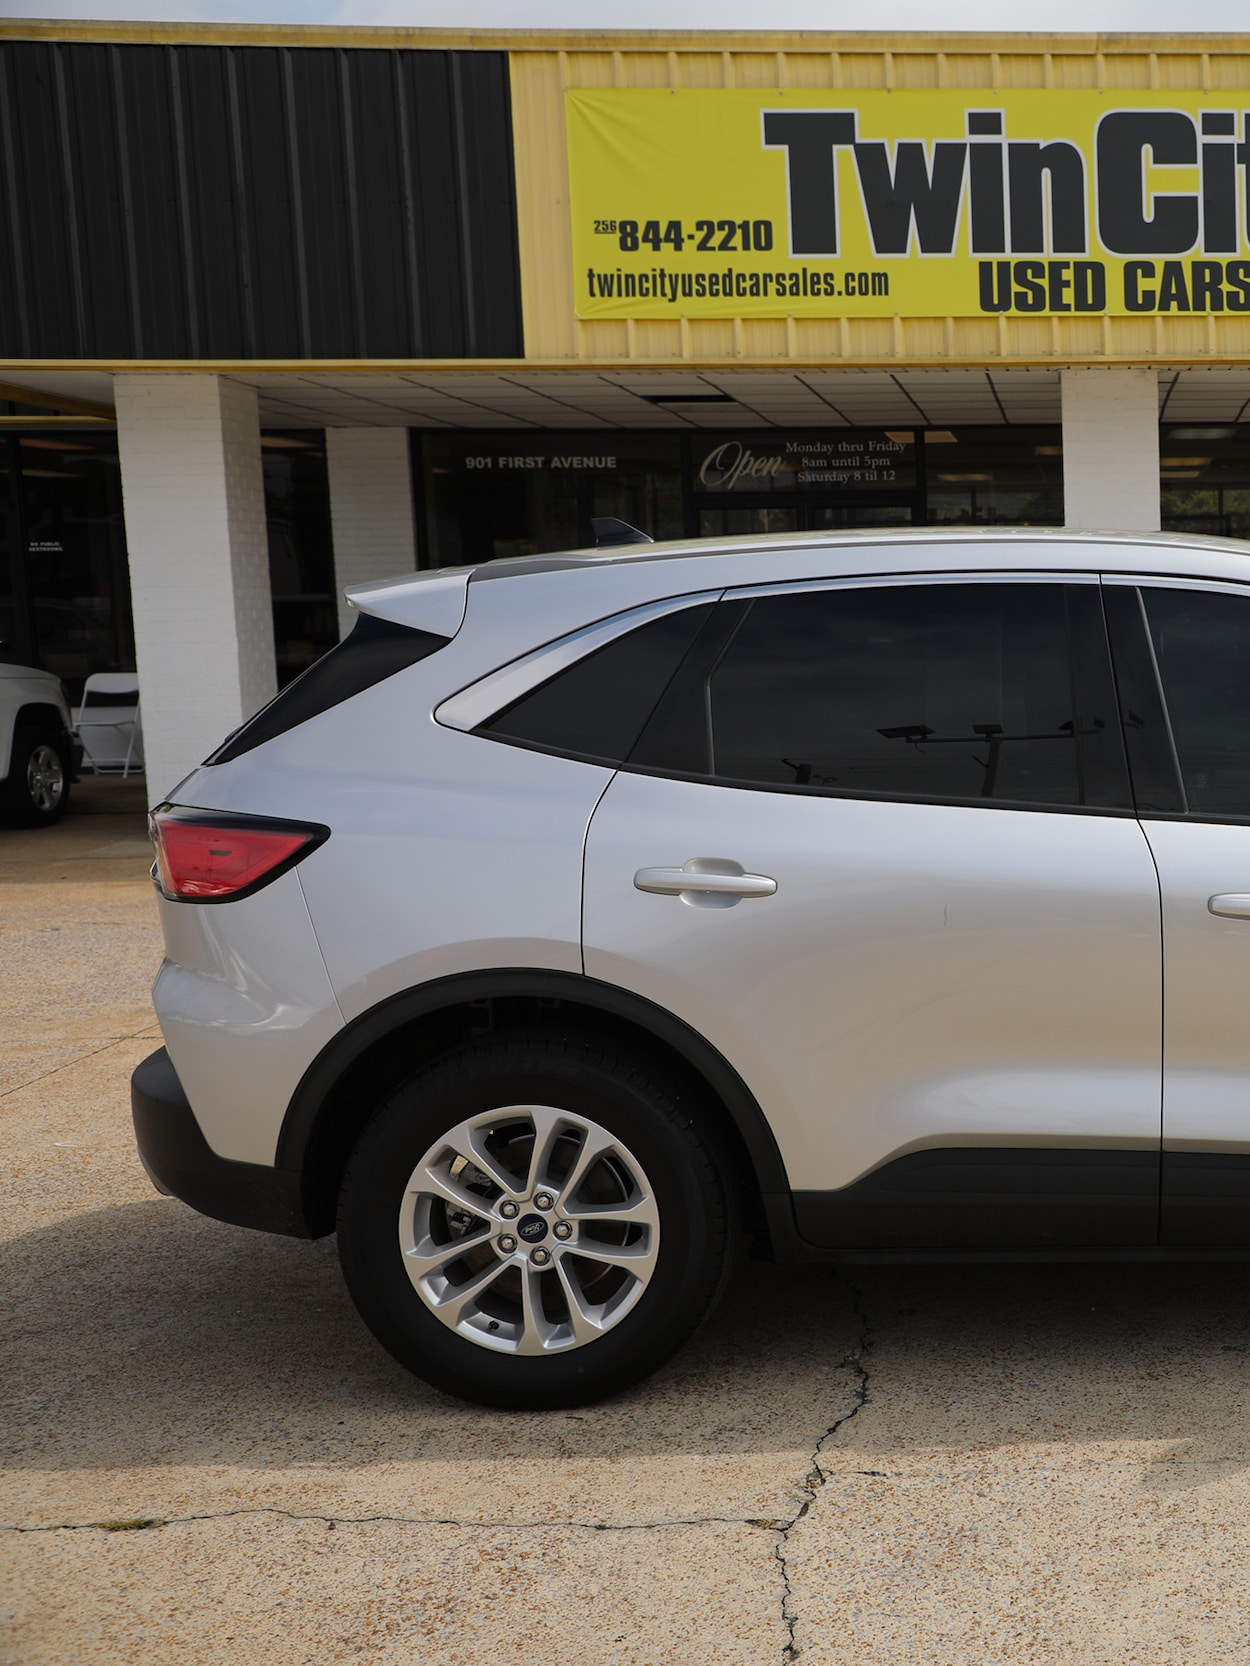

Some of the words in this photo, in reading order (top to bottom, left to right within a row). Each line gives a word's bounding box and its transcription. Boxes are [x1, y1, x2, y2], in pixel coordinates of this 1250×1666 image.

[619, 219, 774, 252] 844-2210
[588, 267, 890, 302] twincityusedcarsales.com
[979, 260, 1107, 312] USED
[785, 442, 834, 455] Monday
[838, 441, 864, 453] thru
[869, 440, 906, 454] Friday
[465, 456, 492, 469] 901
[499, 456, 545, 469] FIRST
[551, 456, 617, 469] AVENUE
[700, 440, 788, 490] Open
[802, 457, 827, 468] 8am
[832, 456, 860, 468] until
[864, 455, 891, 468] 5pm
[797, 471, 850, 484] Saturday
[854, 470, 862, 481] 8
[865, 470, 879, 481] til
[882, 470, 896, 481] 12
